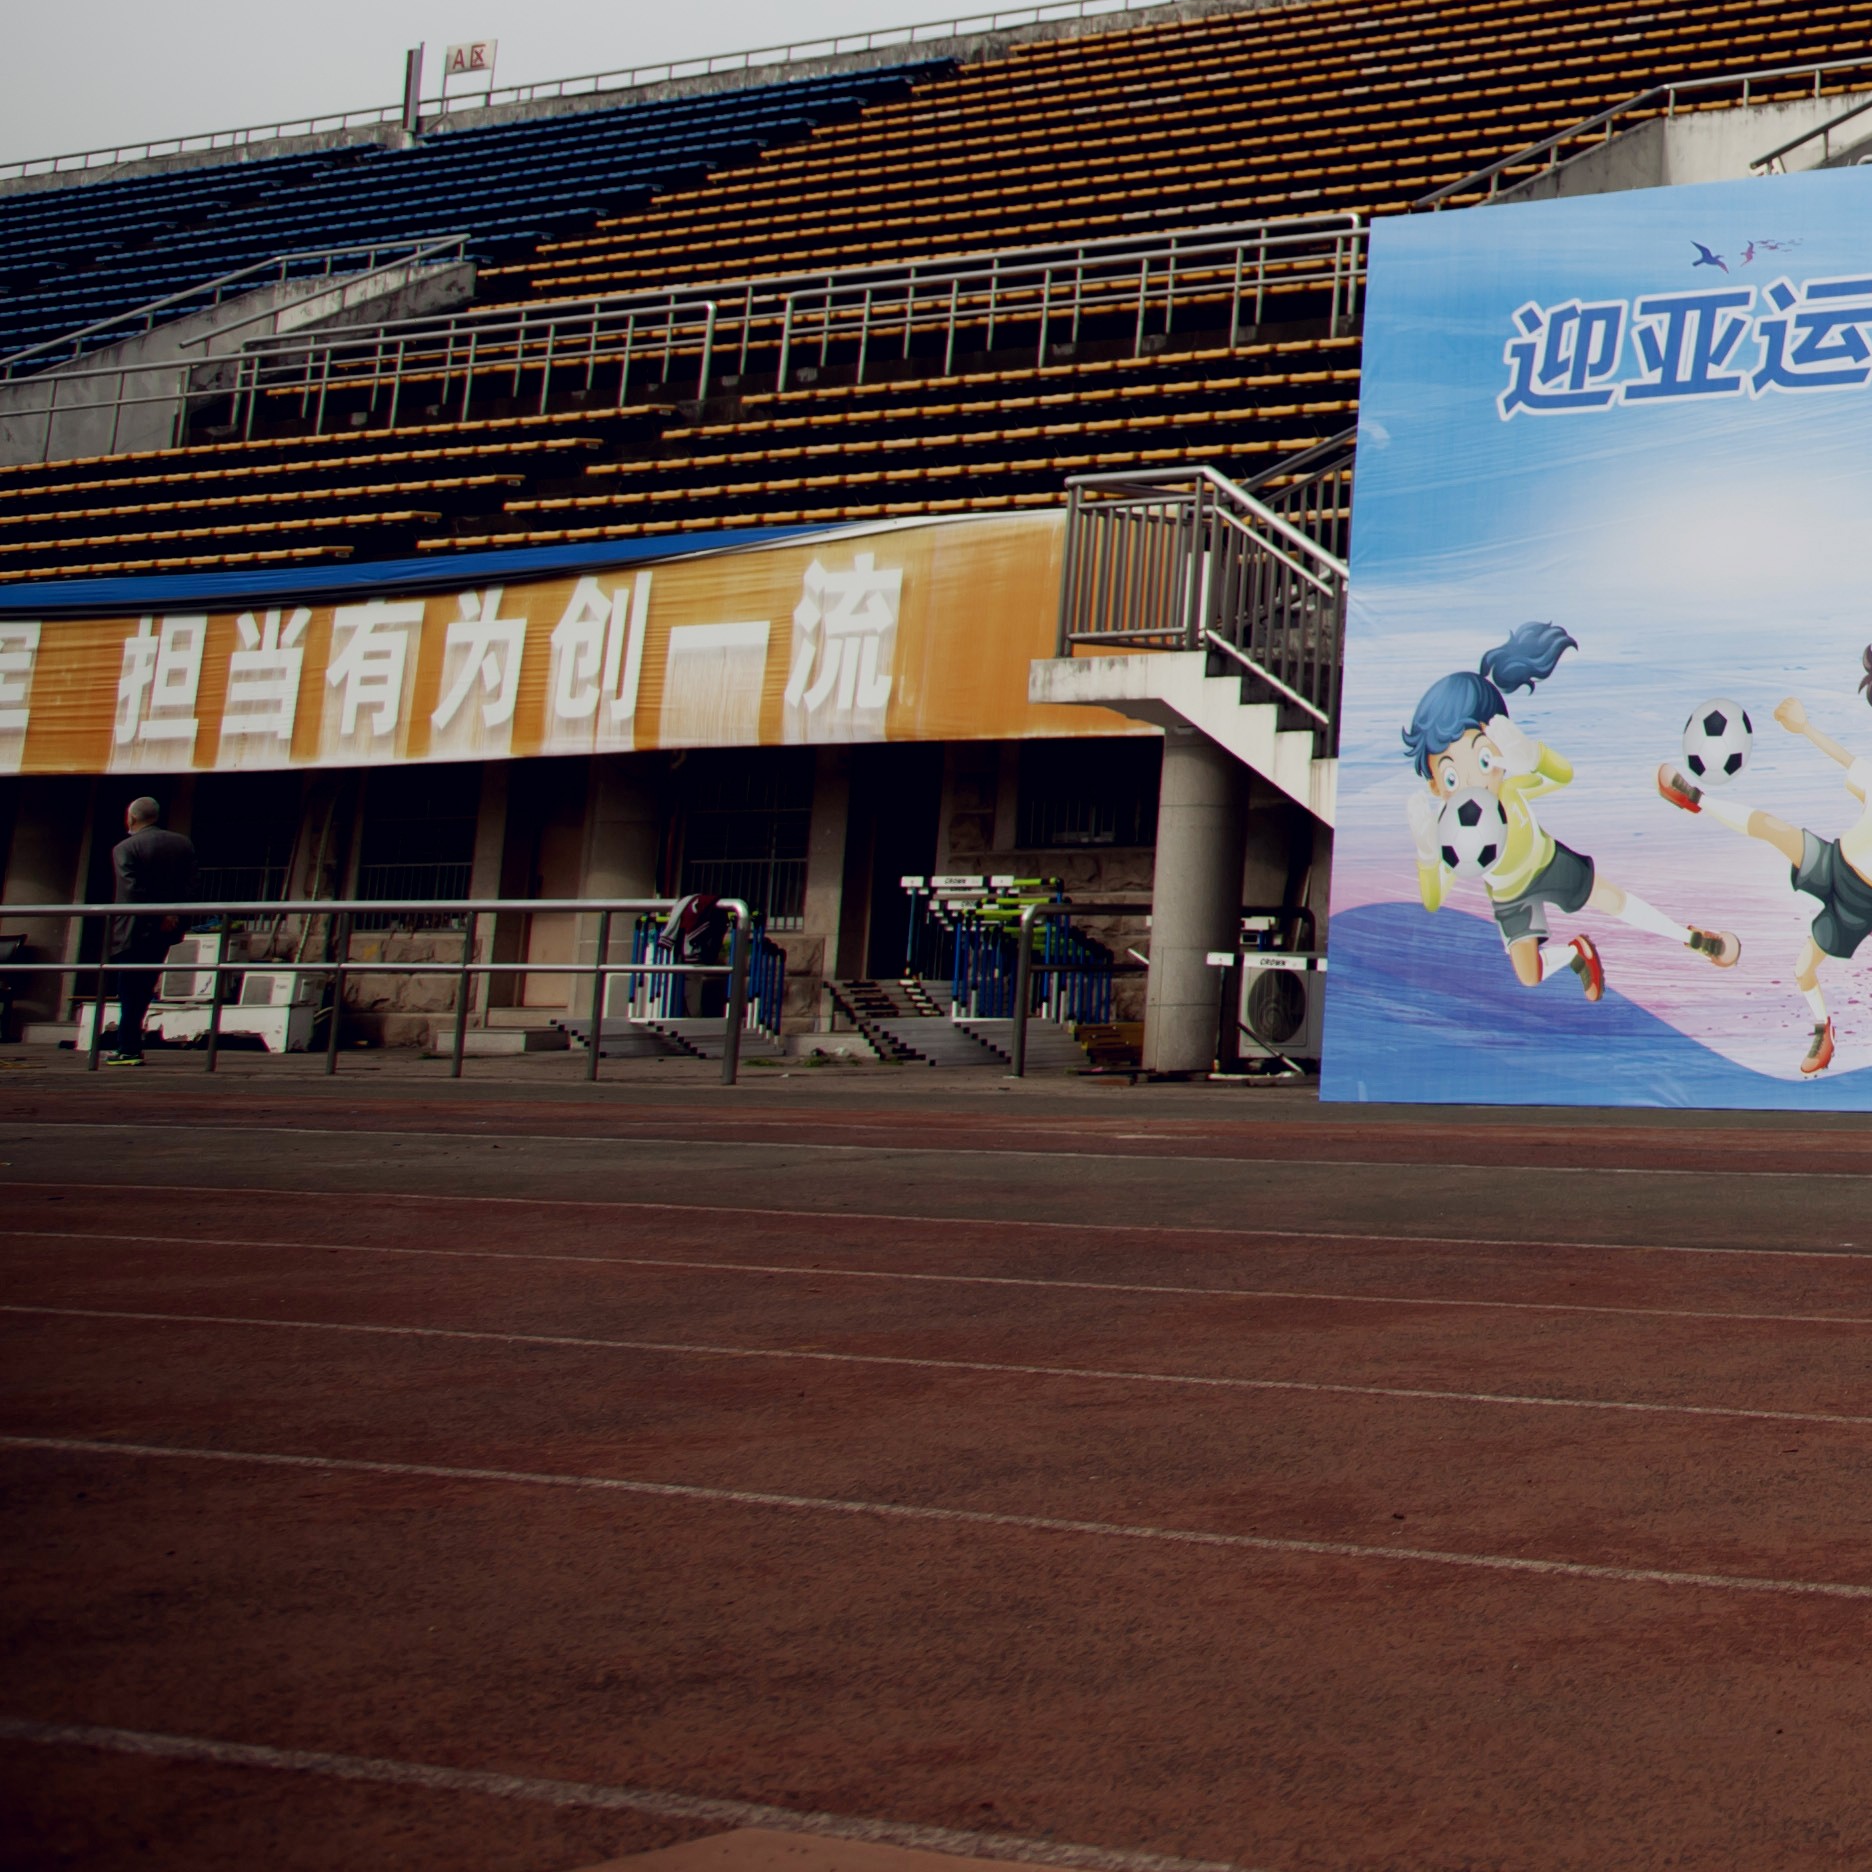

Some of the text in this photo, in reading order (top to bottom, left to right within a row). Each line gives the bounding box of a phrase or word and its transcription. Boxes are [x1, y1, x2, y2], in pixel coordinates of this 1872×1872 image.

[452, 44, 486, 70] A区
[114, 552, 904, 744] 担当有为创一流
